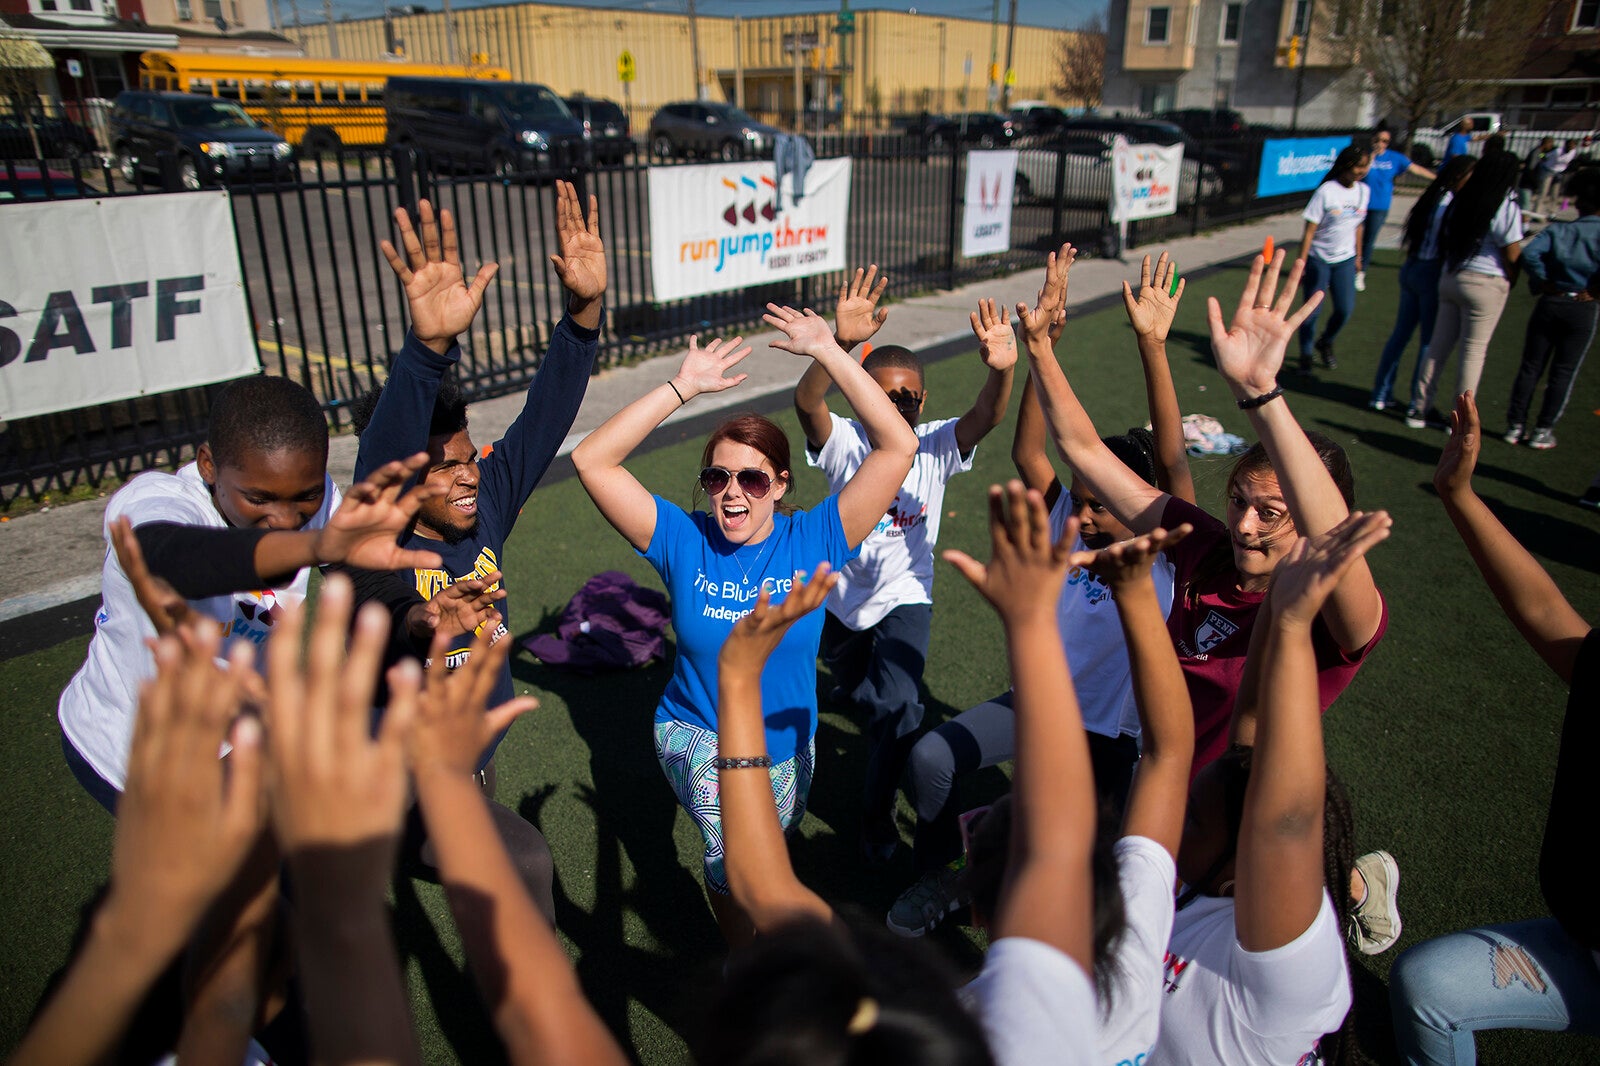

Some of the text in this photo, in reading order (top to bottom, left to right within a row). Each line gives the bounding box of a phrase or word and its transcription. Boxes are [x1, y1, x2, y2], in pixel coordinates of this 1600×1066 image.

[722, 581, 758, 602] Blue
[762, 570, 798, 595] Cre
[1209, 614, 1236, 636] PENN
